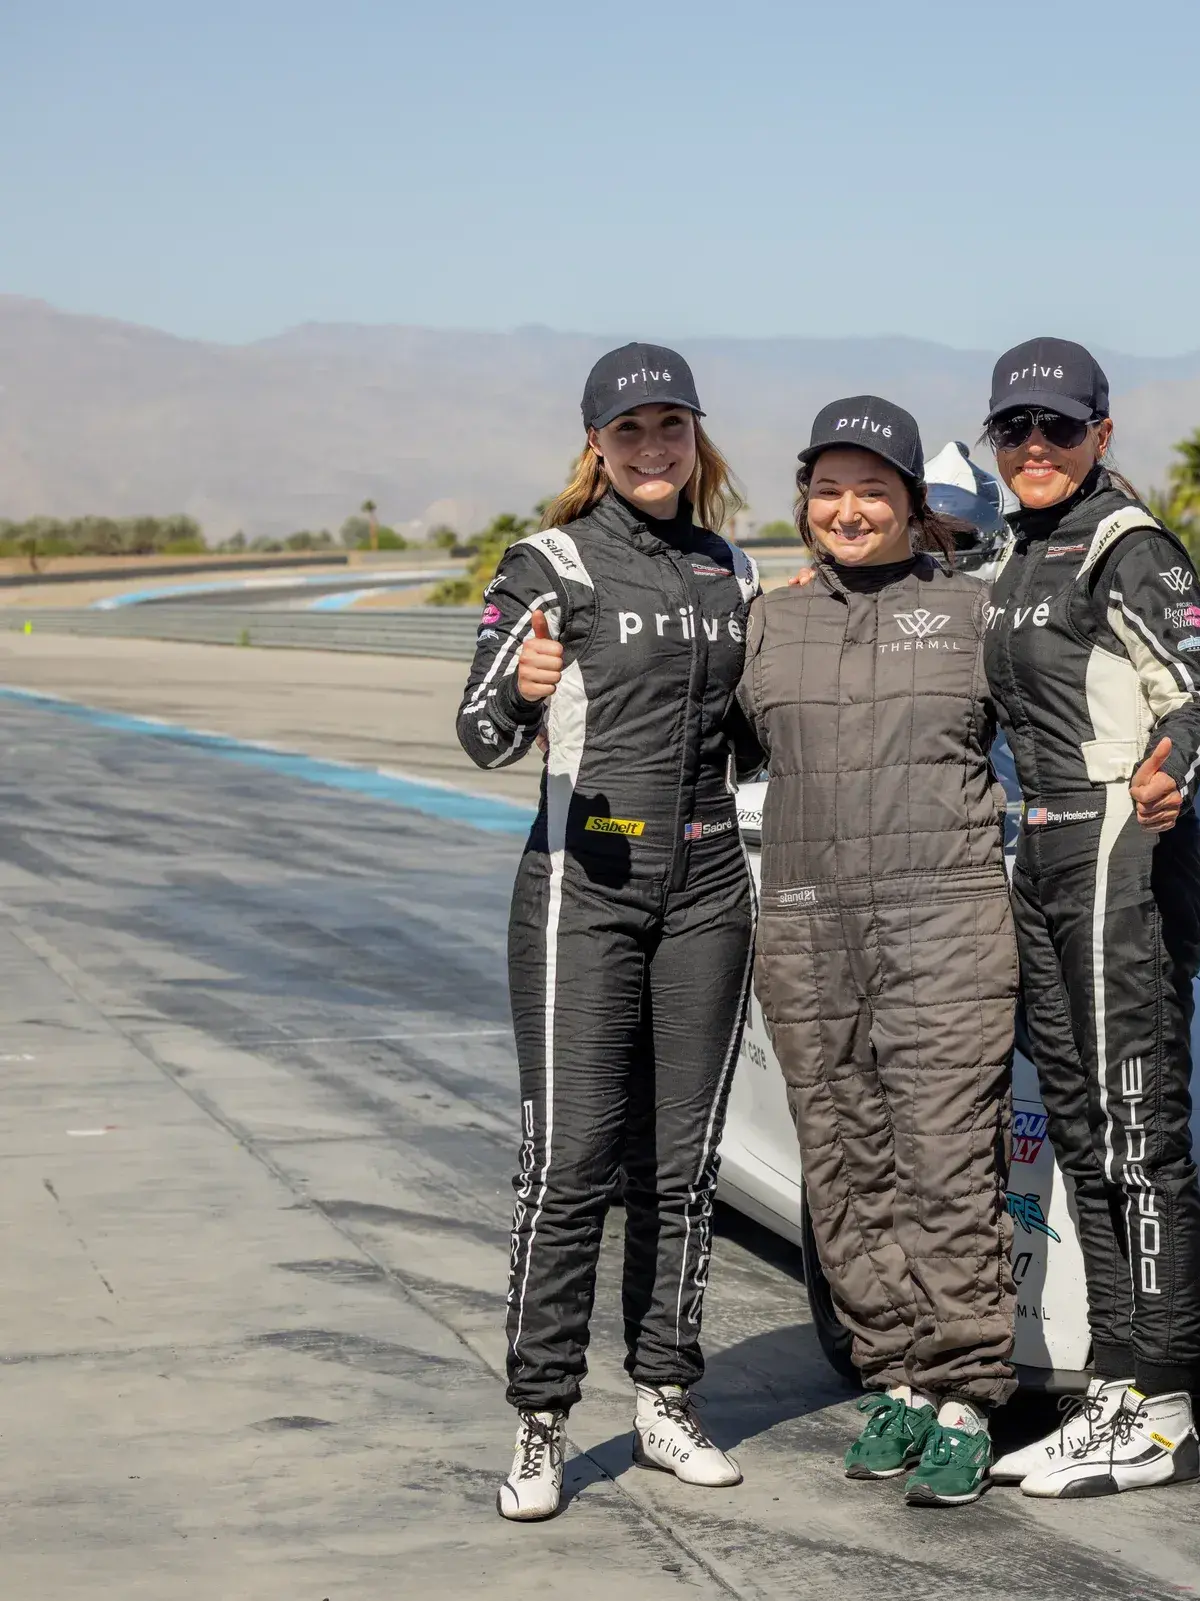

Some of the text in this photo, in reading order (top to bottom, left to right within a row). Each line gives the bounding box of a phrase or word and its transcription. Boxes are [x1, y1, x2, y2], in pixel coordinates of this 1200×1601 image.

[617, 367, 672, 390] privé
[1009, 363, 1064, 385] privé
[835, 416, 893, 438] privé
[540, 538, 577, 571] Sabelt
[618, 605, 746, 644] privé
[878, 640, 961, 654] THERMAL
[591, 818, 638, 834] Sabelt
[702, 817, 732, 835] Sabré
[1047, 809, 1099, 823] Shay Hoelscher
[648, 1431, 693, 1463] privé
